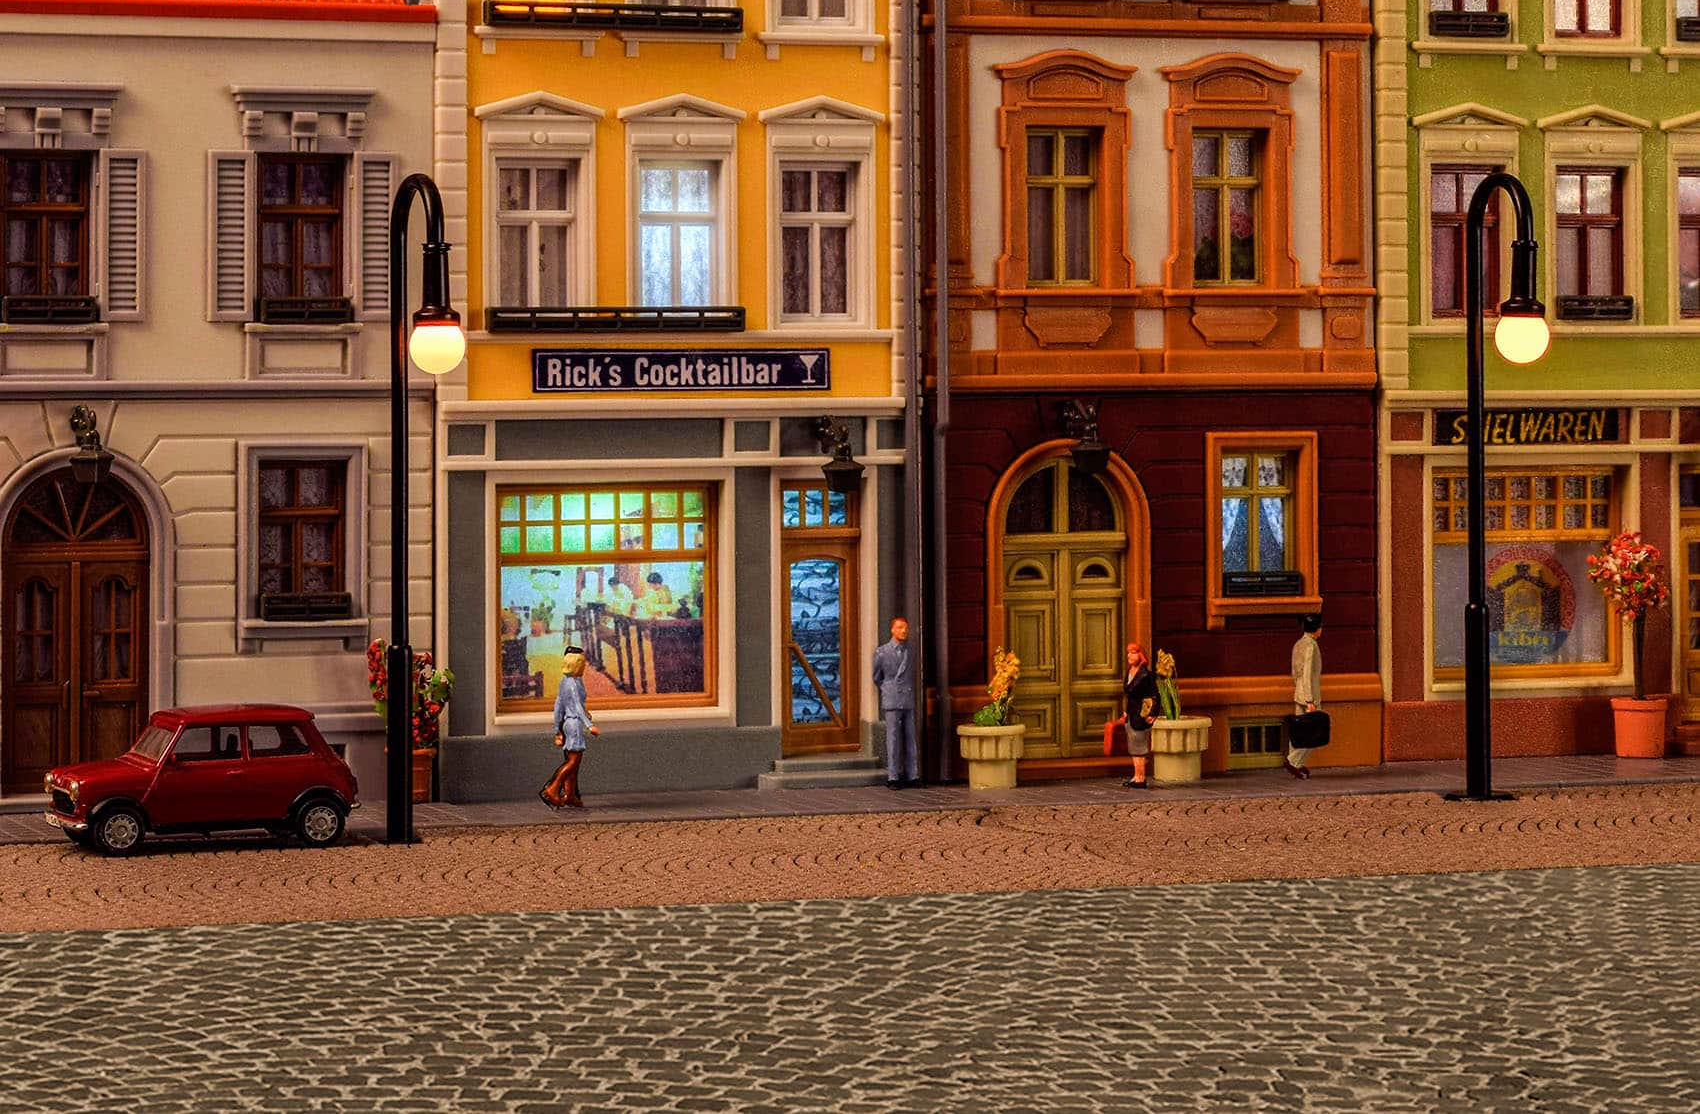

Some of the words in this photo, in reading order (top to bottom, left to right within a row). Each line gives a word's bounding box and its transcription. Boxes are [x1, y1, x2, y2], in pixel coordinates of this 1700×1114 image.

[547, 357, 622, 386] Rick's
[634, 356, 782, 385] Cocktailbar
[1451, 411, 1606, 444] SIELWAREN
